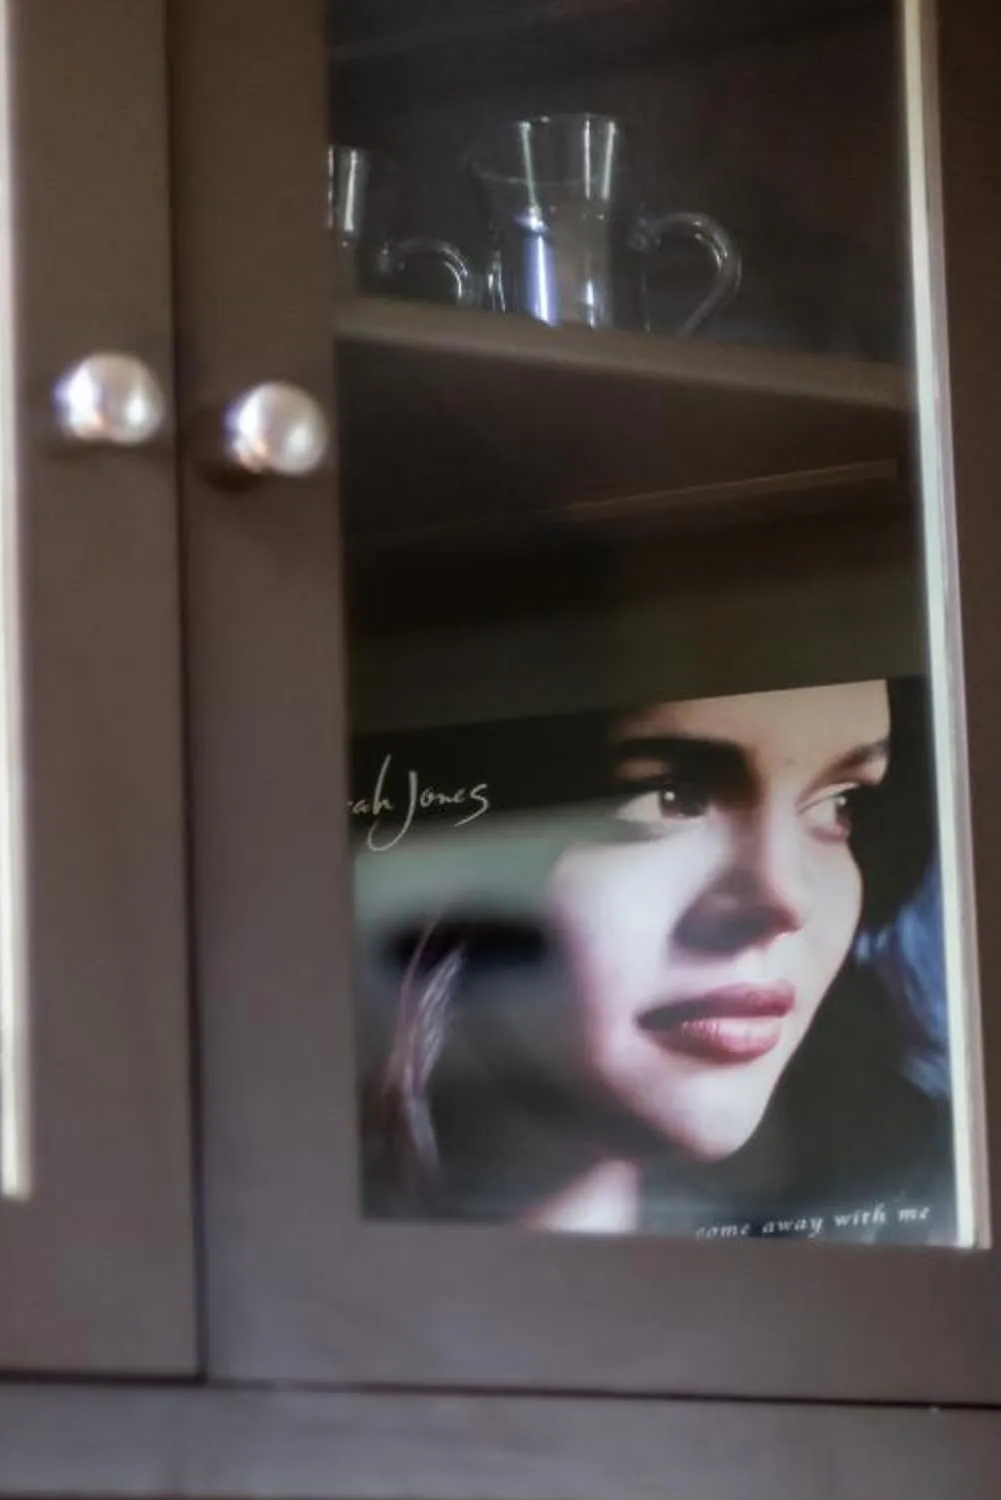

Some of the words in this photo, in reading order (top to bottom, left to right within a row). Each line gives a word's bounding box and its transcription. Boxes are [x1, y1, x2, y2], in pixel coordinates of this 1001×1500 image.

[366, 770, 489, 851] Jones
[762, 1215, 824, 1239] away
[834, 1202, 886, 1228] with
[898, 1206, 930, 1223] me
